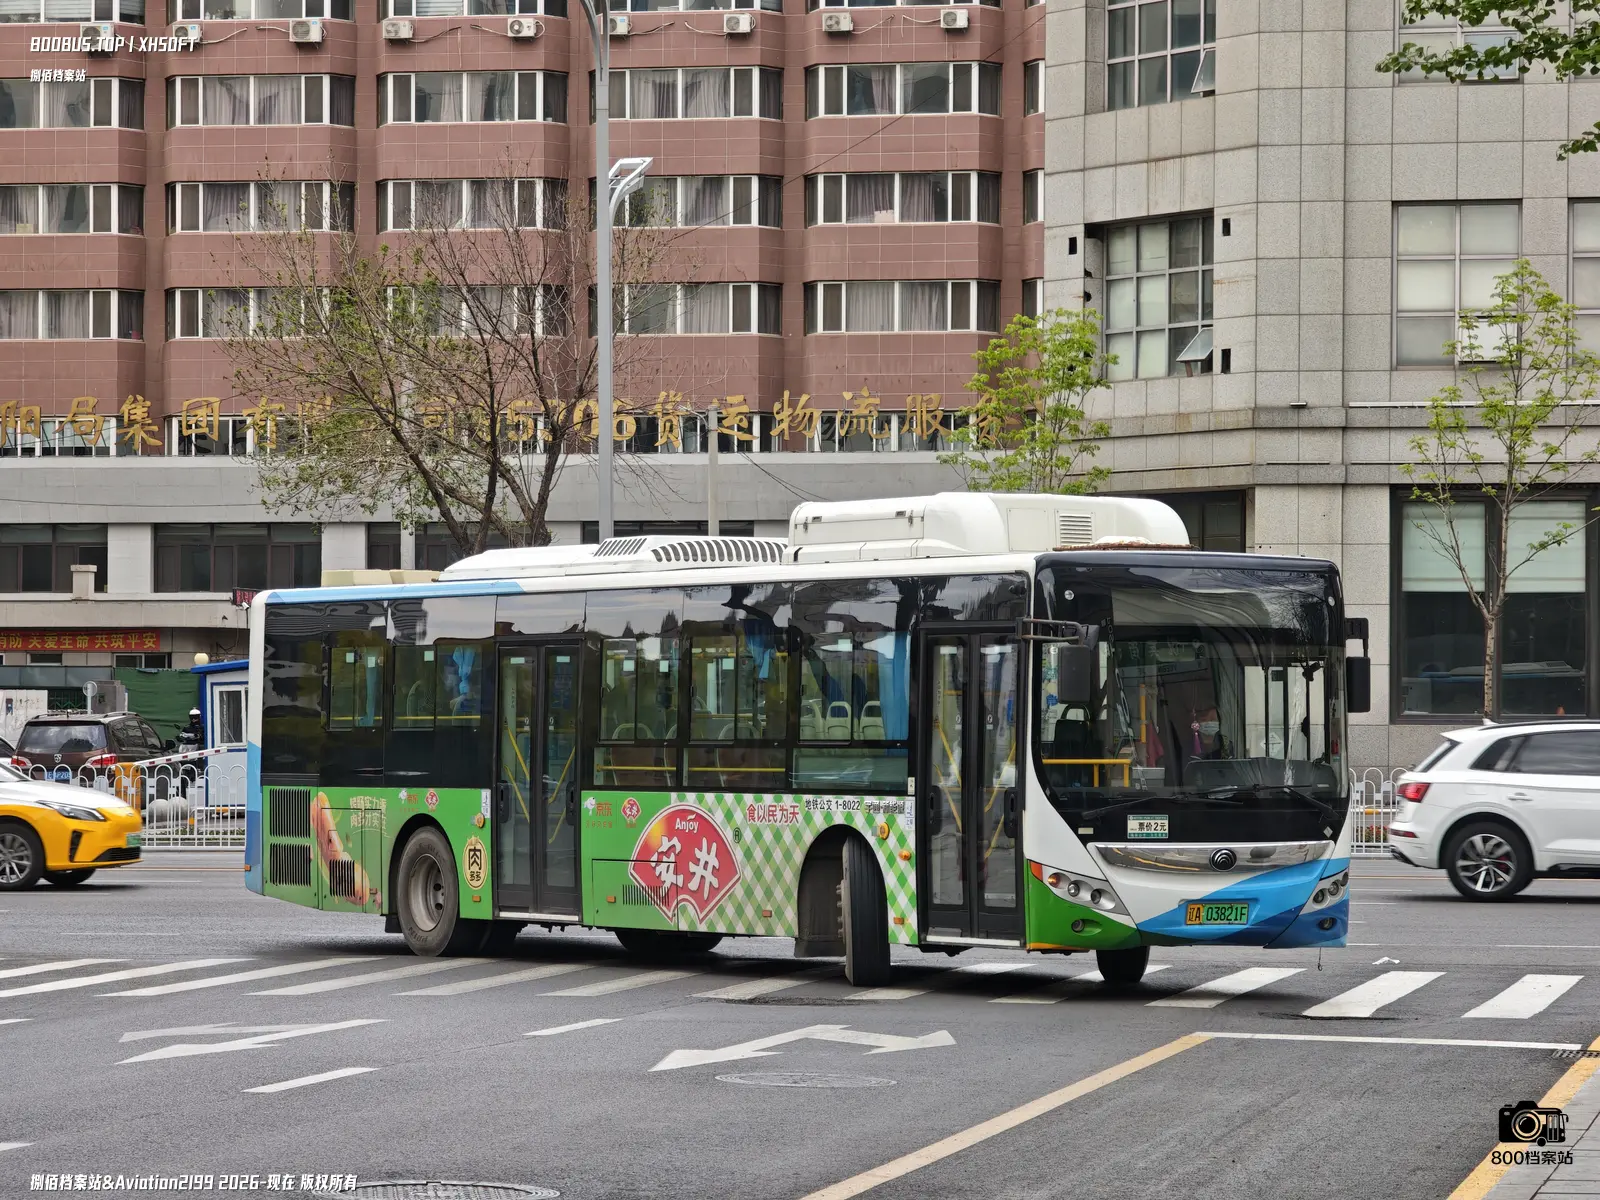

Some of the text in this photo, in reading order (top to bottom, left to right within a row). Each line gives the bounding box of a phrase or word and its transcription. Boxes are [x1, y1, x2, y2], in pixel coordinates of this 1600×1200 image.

[28, 633, 89, 649] 关爱生命
[95, 633, 157, 649] 共筑平安
[805, 799, 861, 811] 地铁公交 1-8022
[746, 804, 800, 824] 食以民为天
[675, 817, 699, 834] Anjoy
[1138, 821, 1167, 832] 票价2元
[650, 836, 720, 901] 安井
[1206, 906, 1247, 922] 03821F
